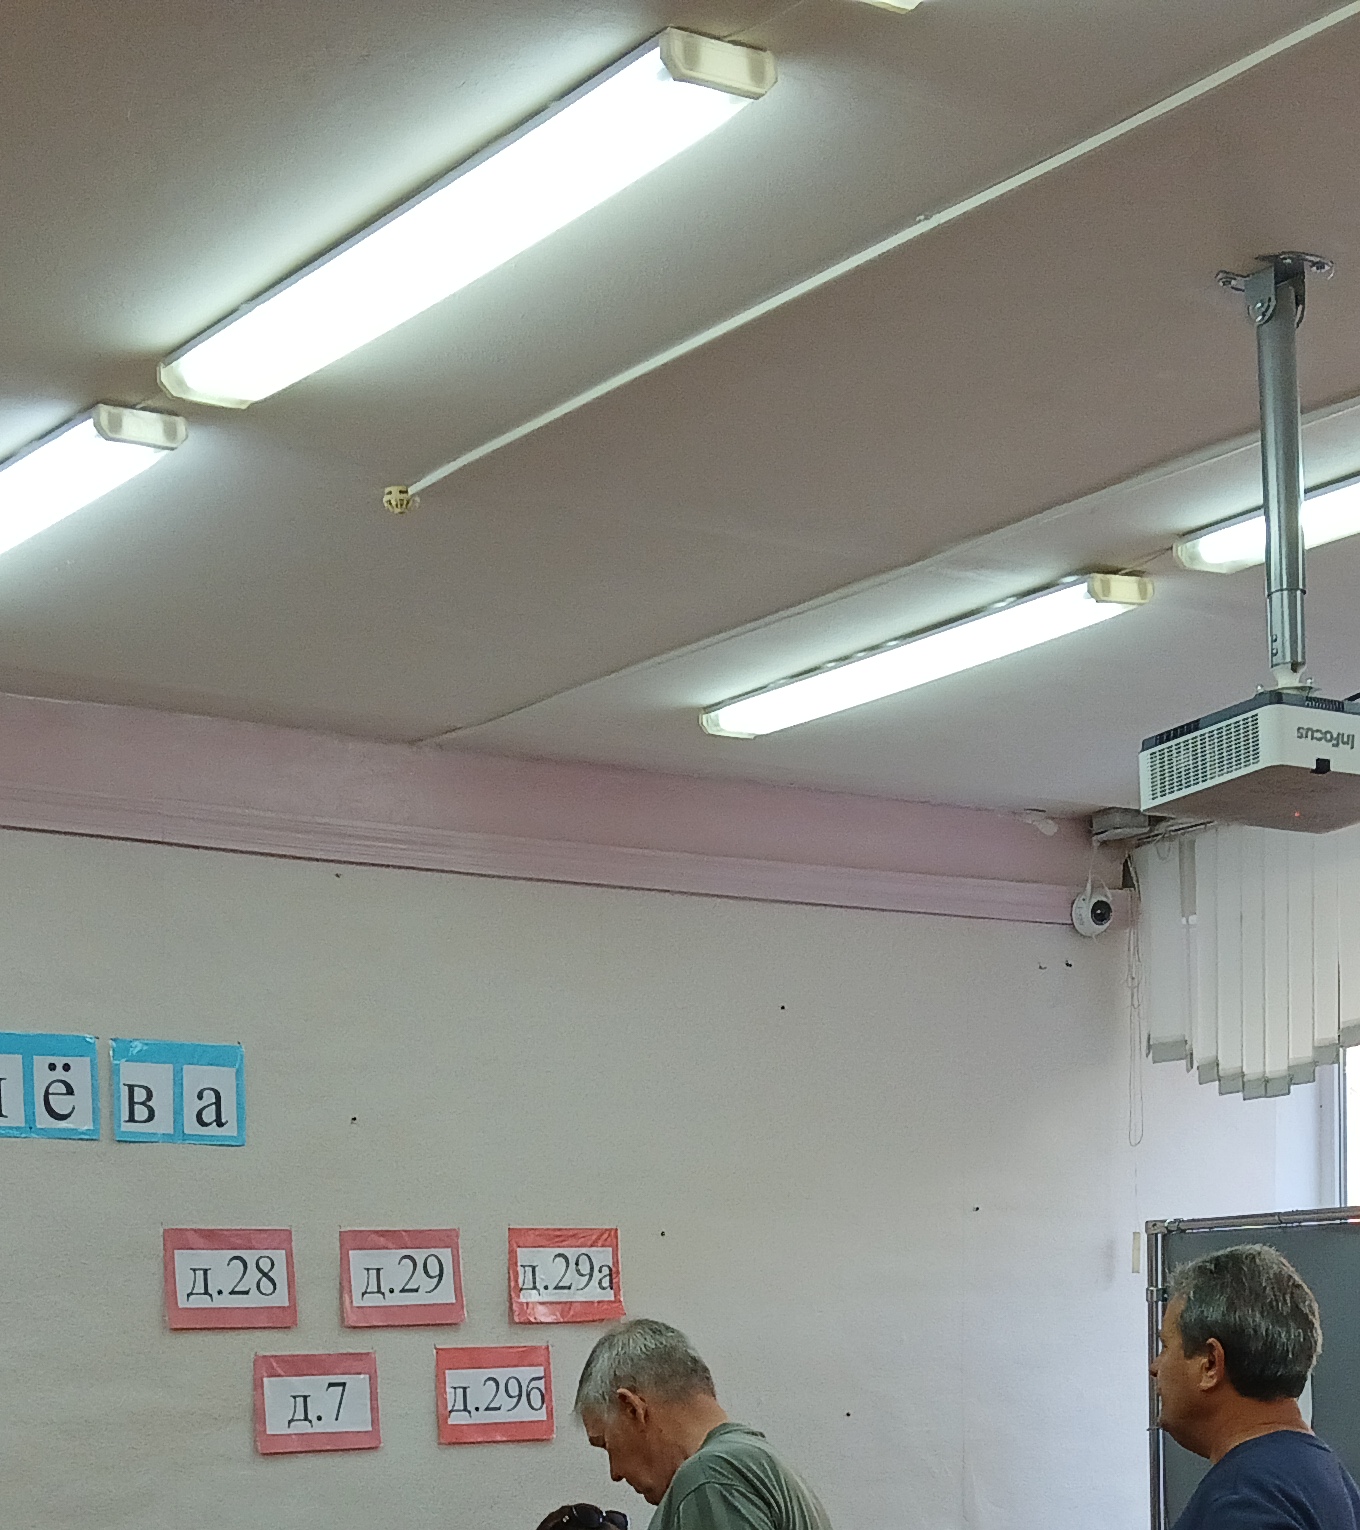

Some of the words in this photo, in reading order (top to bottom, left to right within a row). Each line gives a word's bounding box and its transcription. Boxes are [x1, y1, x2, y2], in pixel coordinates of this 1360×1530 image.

[186, 1254, 278, 1303] д.28
[361, 1253, 445, 1301] д.29
[517, 1252, 614, 1293] д.29а
[287, 1381, 349, 1429] д.7
[448, 1375, 546, 1418] д.29б
